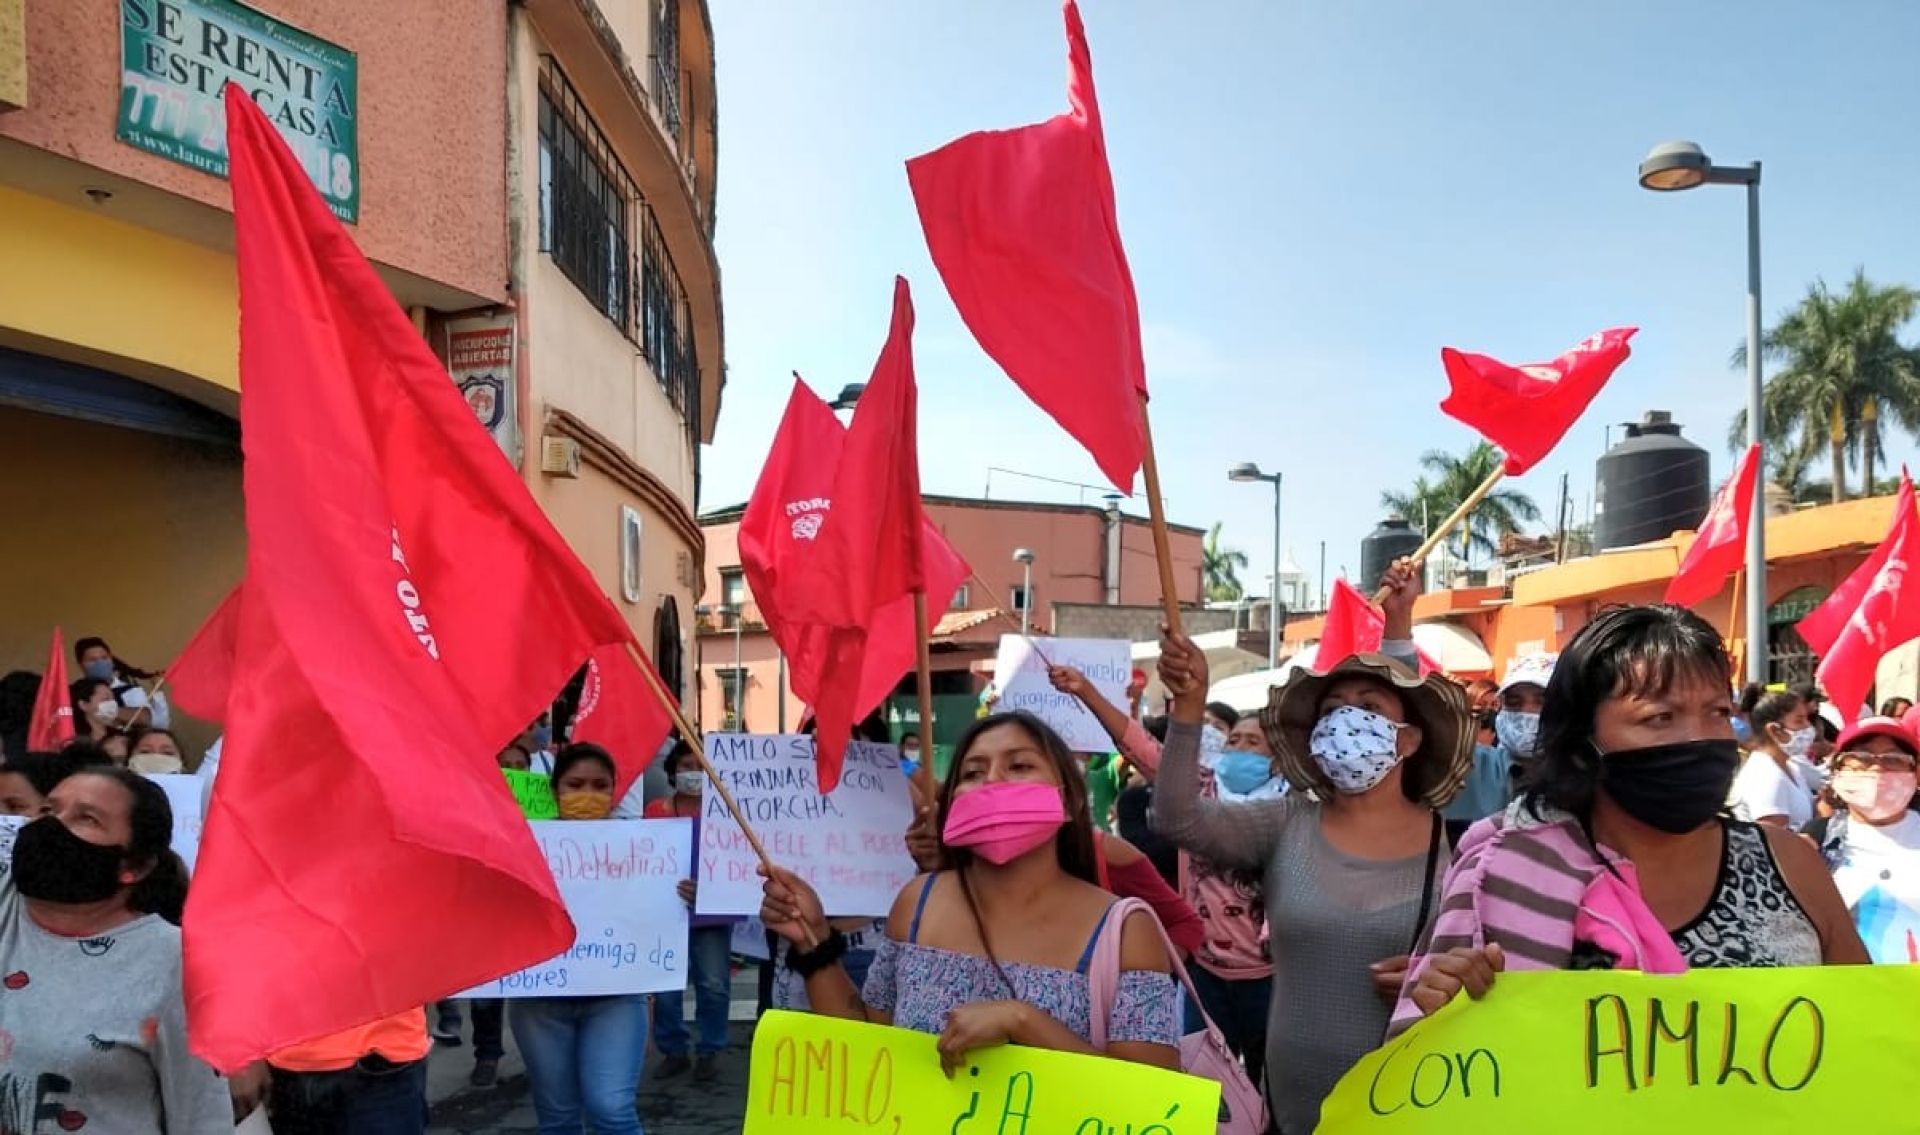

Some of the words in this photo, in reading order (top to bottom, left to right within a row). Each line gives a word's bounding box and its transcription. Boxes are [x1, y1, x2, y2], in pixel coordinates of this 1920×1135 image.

[126, 0, 185, 45] SE
[199, 18, 350, 117] RENTA
[125, 72, 190, 138] 777
[126, 130, 228, 176] www.laurai
[712, 738, 777, 762] AMLO
[842, 768, 885, 793] CON
[705, 824, 810, 858] CUMLELE
[703, 856, 718, 882] Y
[563, 927, 637, 968] nemiga
[649, 936, 676, 972] de
[1367, 1031, 1501, 1116] Con
[1584, 993, 1825, 1093] AMLO
[767, 1036, 902, 1135] AMLO,
